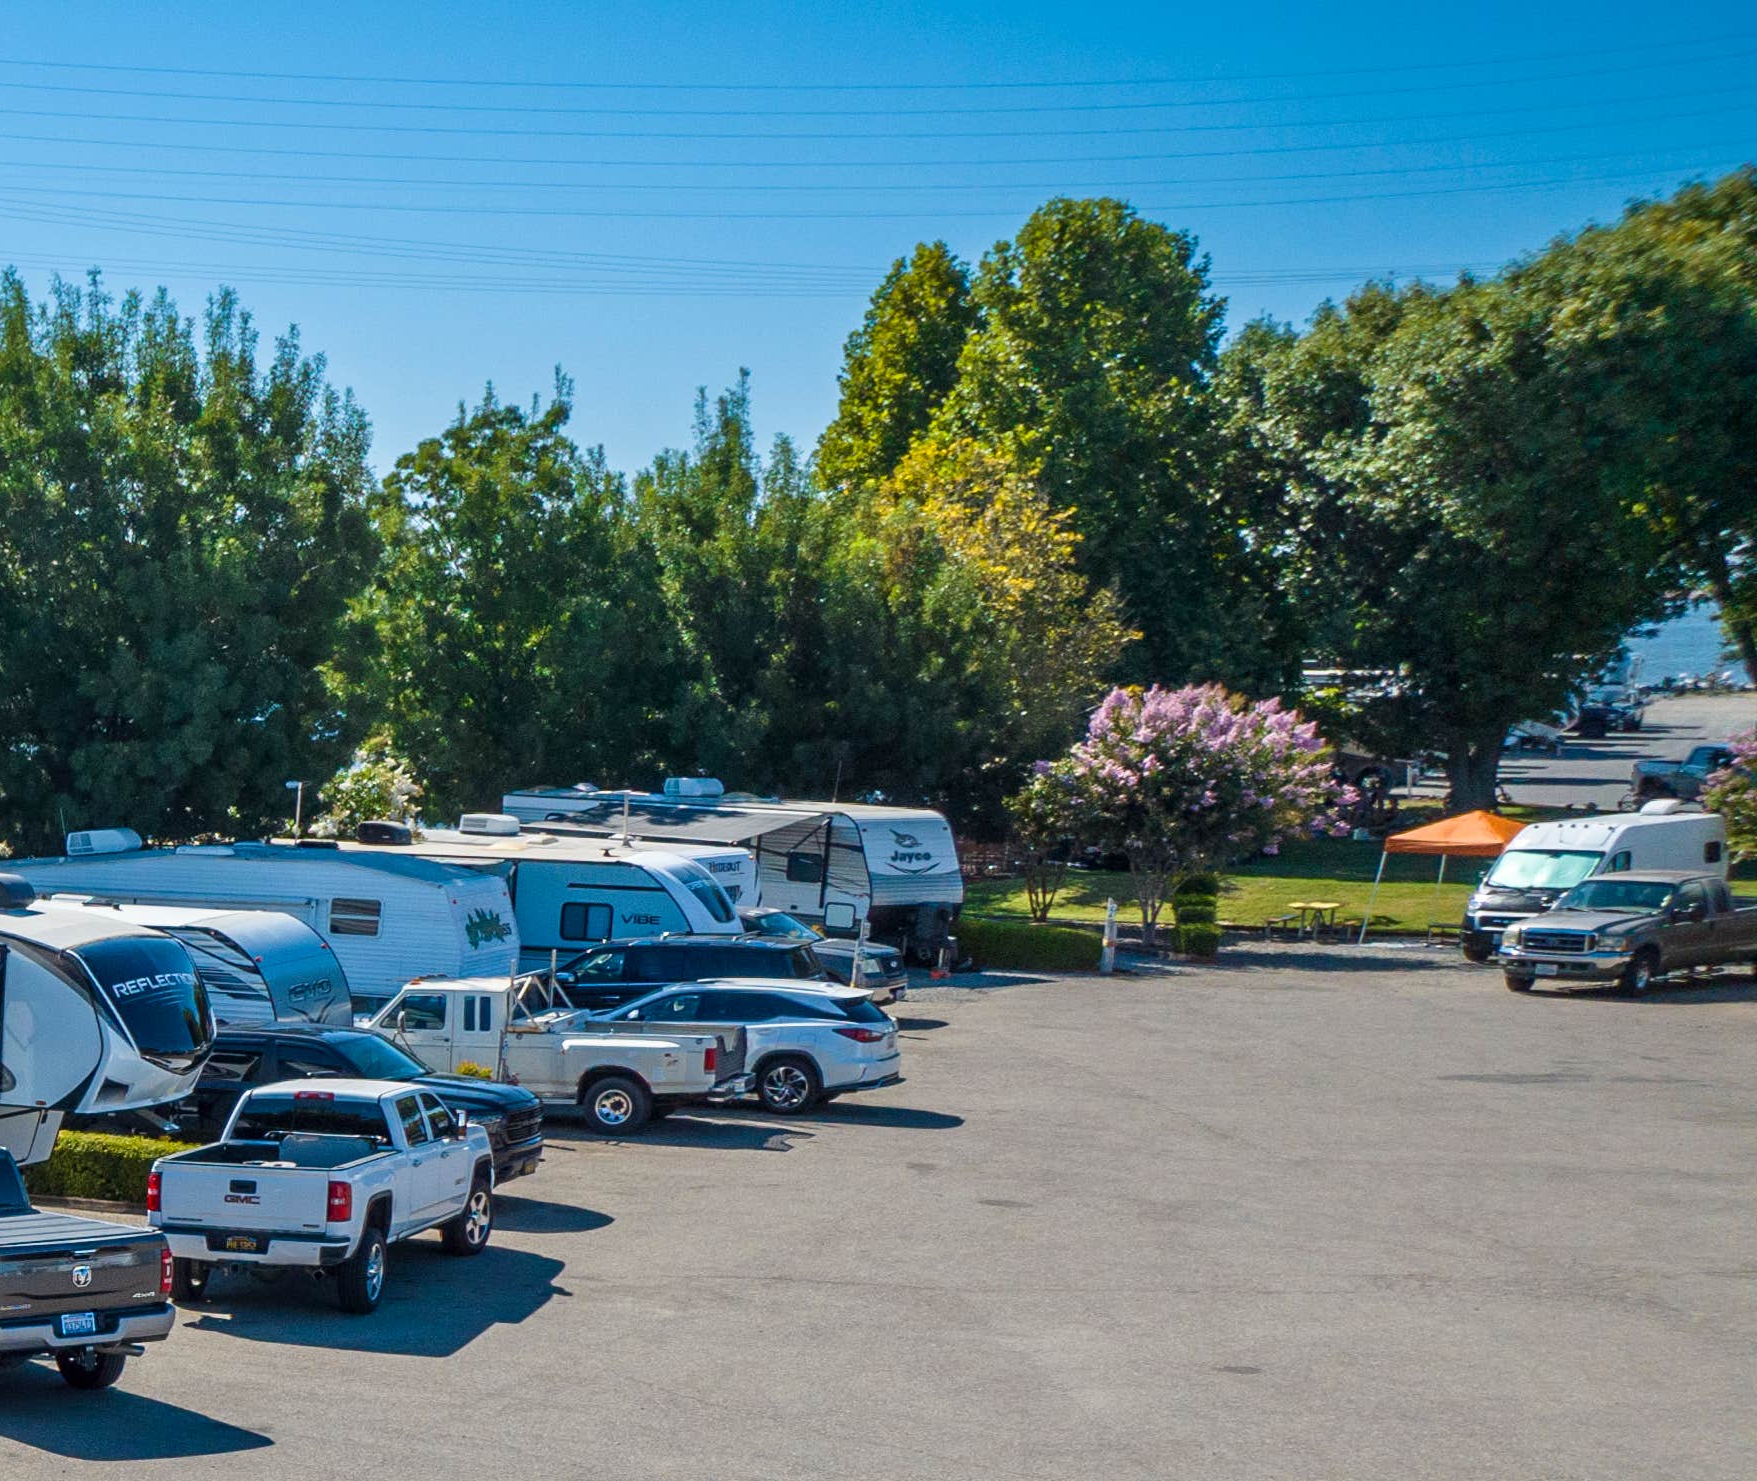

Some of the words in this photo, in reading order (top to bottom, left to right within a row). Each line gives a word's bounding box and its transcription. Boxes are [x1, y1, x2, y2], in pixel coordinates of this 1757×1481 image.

[890, 850, 932, 863] Jayco
[621, 914, 662, 926] VIBE
[224, 1194, 261, 1205] GMC
